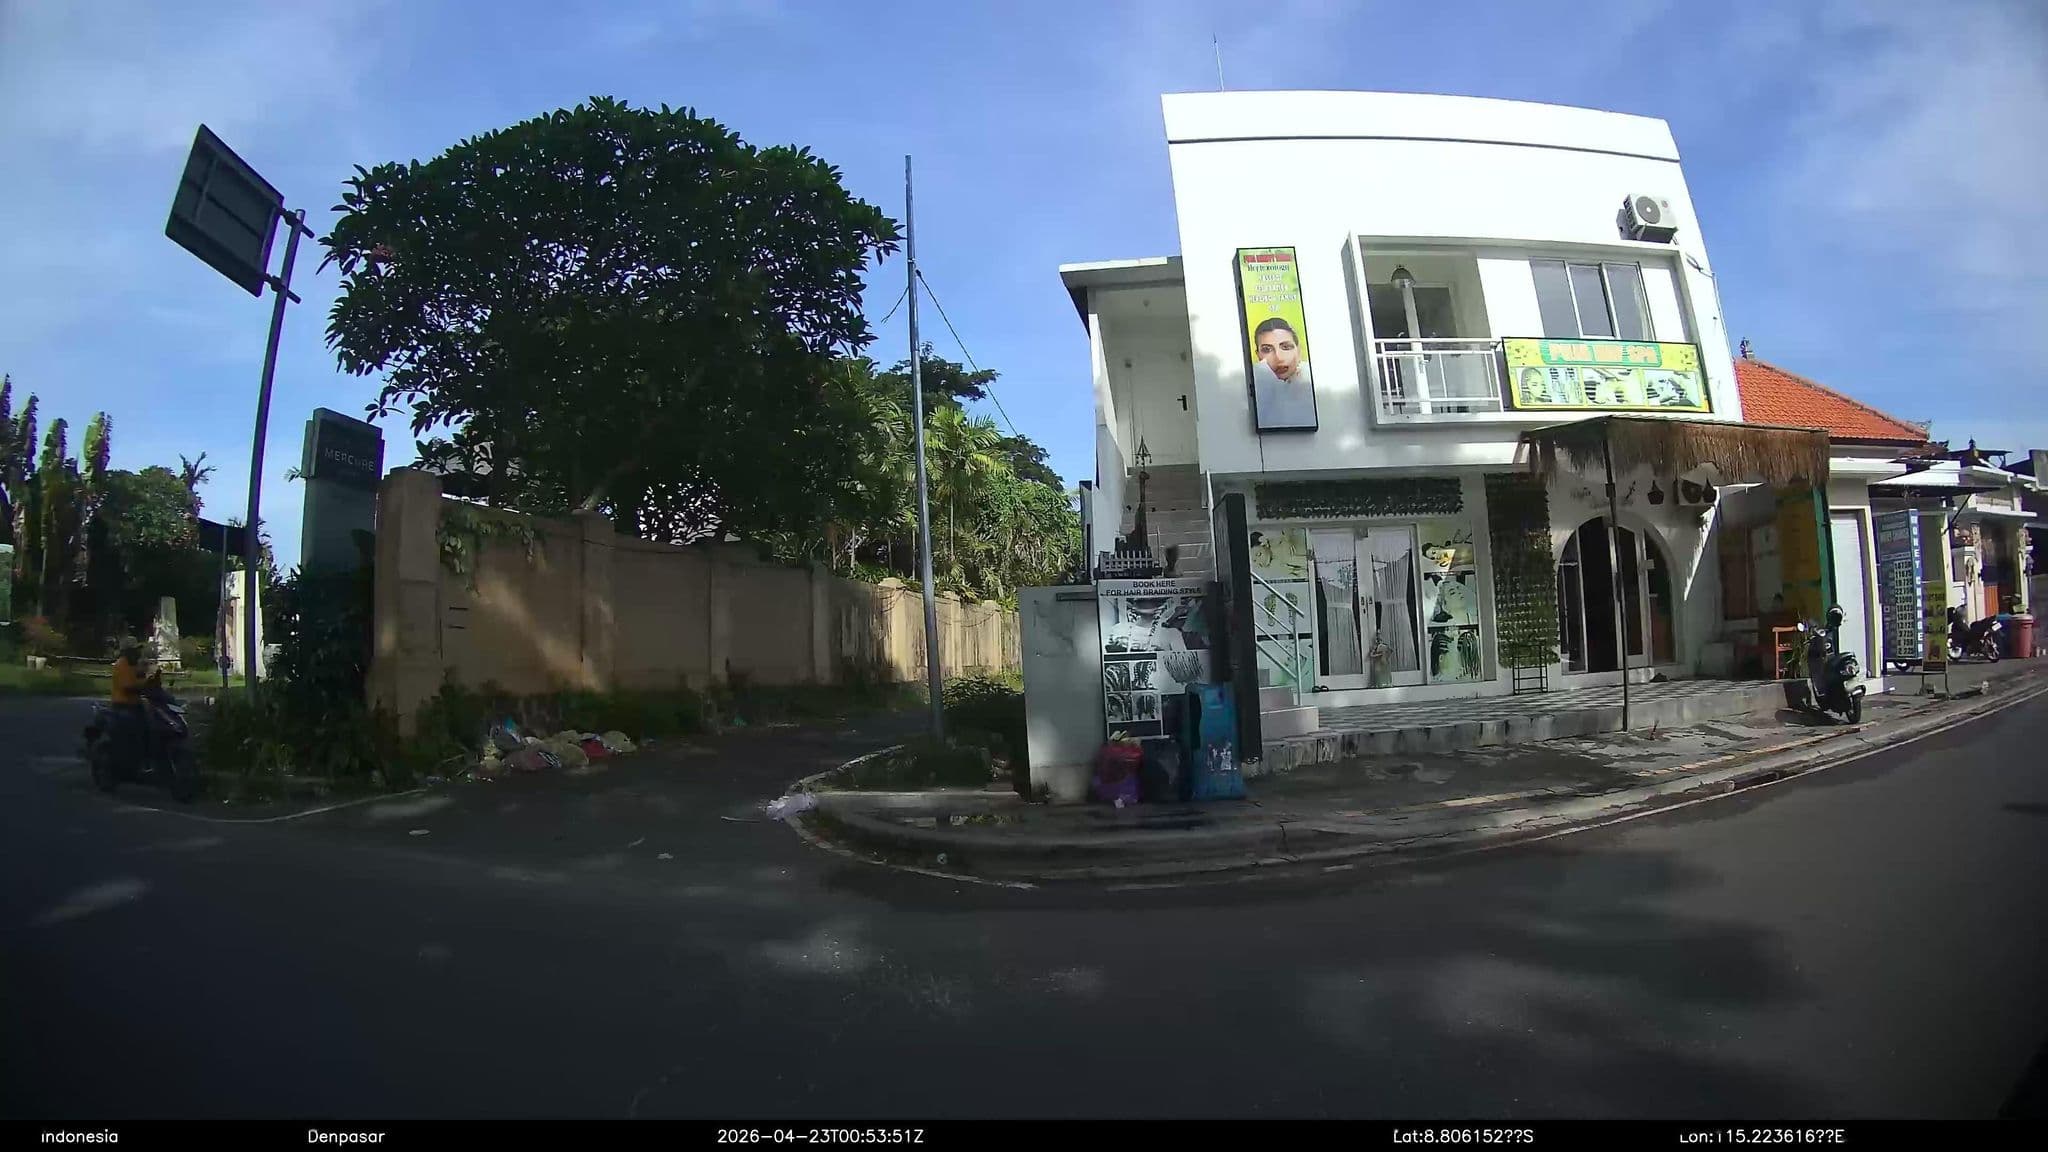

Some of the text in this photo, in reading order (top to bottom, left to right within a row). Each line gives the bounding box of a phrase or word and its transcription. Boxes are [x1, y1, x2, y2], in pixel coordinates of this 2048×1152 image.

[1133, 580, 1155, 588] BOOK
[1124, 588, 1141, 596] HAIR
[1143, 588, 1179, 596] BRAIDING
